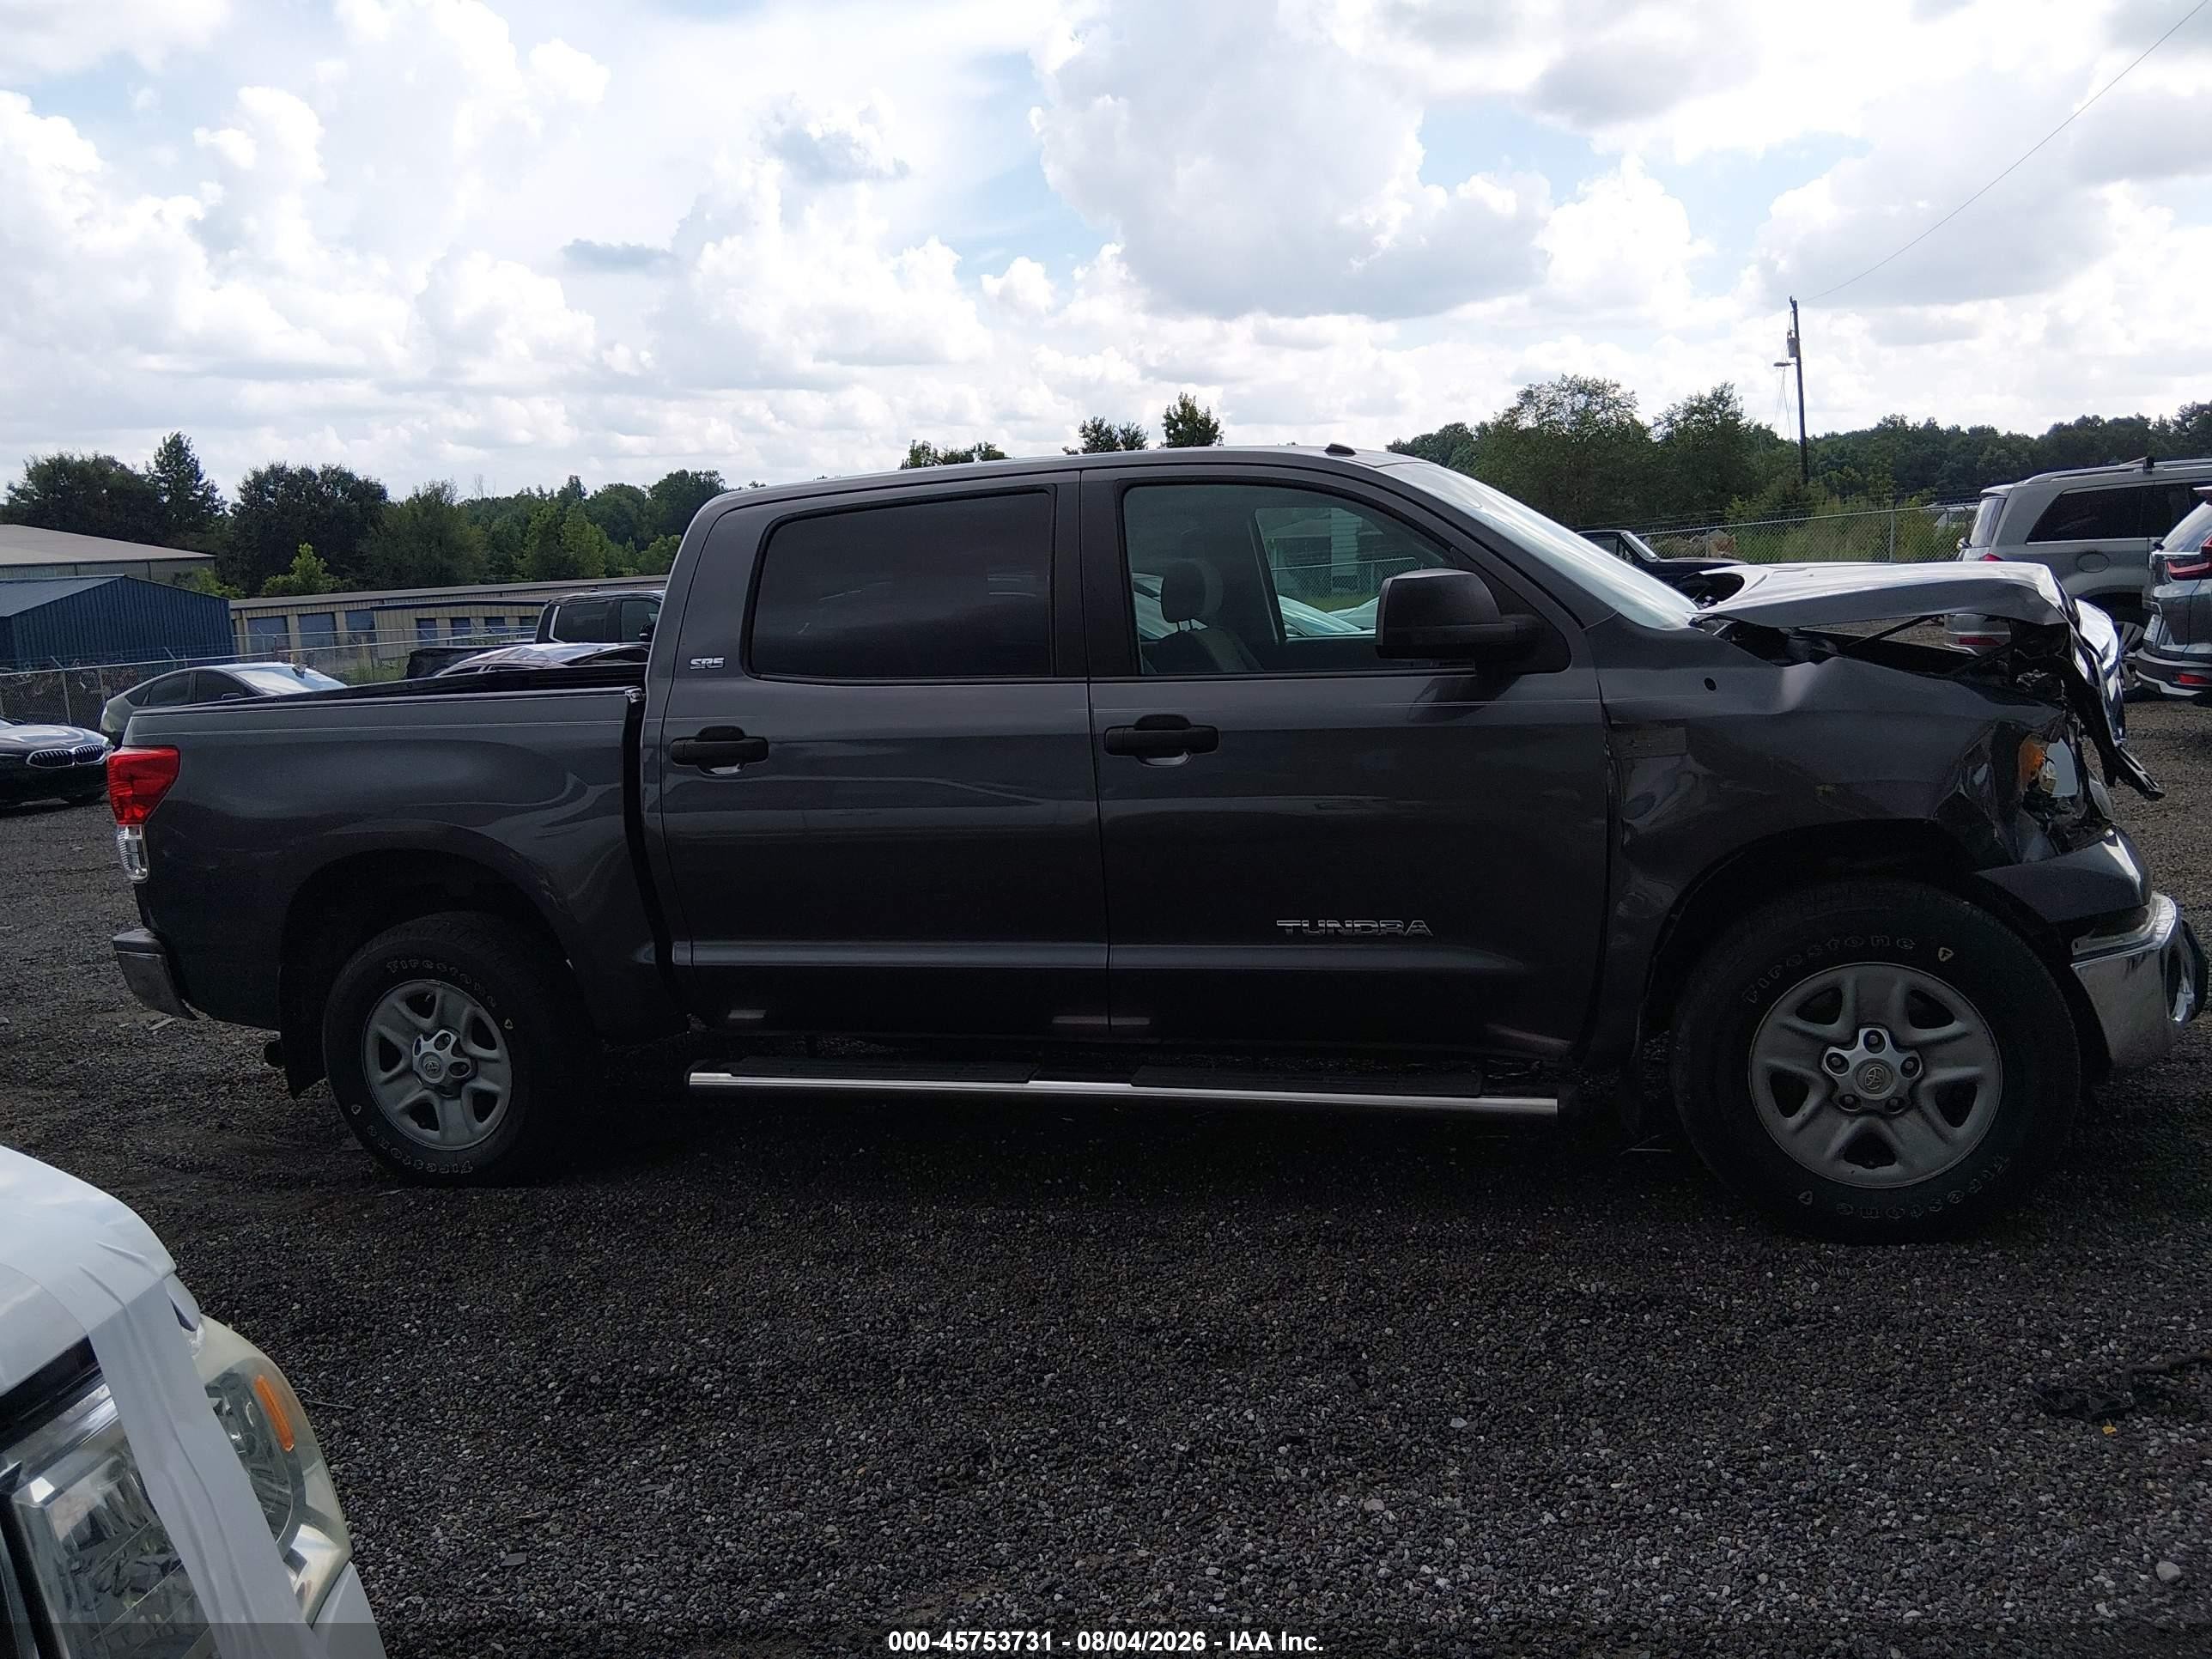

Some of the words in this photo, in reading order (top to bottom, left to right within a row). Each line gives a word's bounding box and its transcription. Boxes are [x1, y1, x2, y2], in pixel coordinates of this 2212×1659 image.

[689, 657, 725, 670] SR5
[1276, 920, 1434, 937] TUNDRA
[1741, 933, 1917, 1004] Firestone
